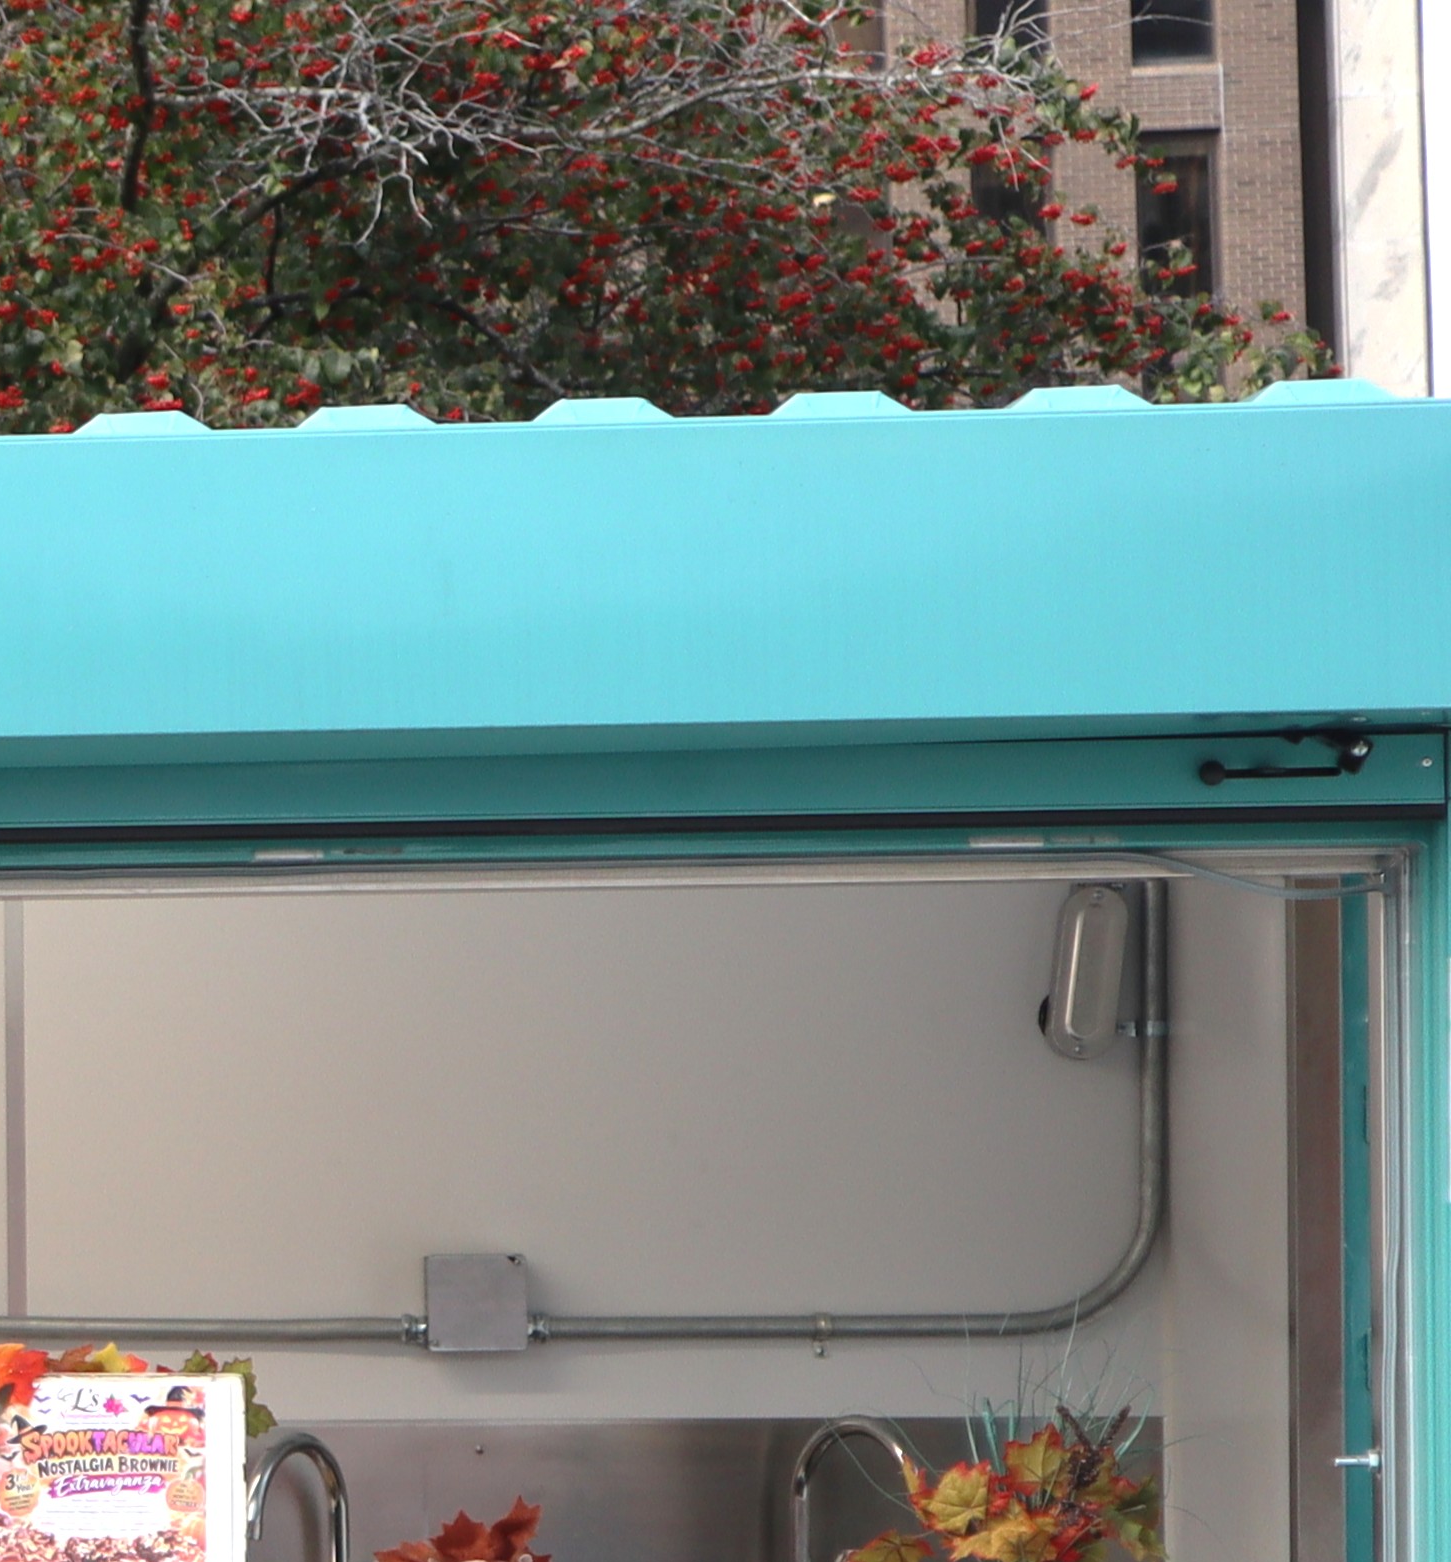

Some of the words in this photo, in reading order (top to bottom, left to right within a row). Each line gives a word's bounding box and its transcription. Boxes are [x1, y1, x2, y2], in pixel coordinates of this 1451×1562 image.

[20, 1429, 179, 1464] SPOOKTACULAR
[37, 1457, 114, 1478] NOSTALGIA
[117, 1456, 179, 1473] BROWNIE
[56, 1475, 164, 1496] Extravaganza
